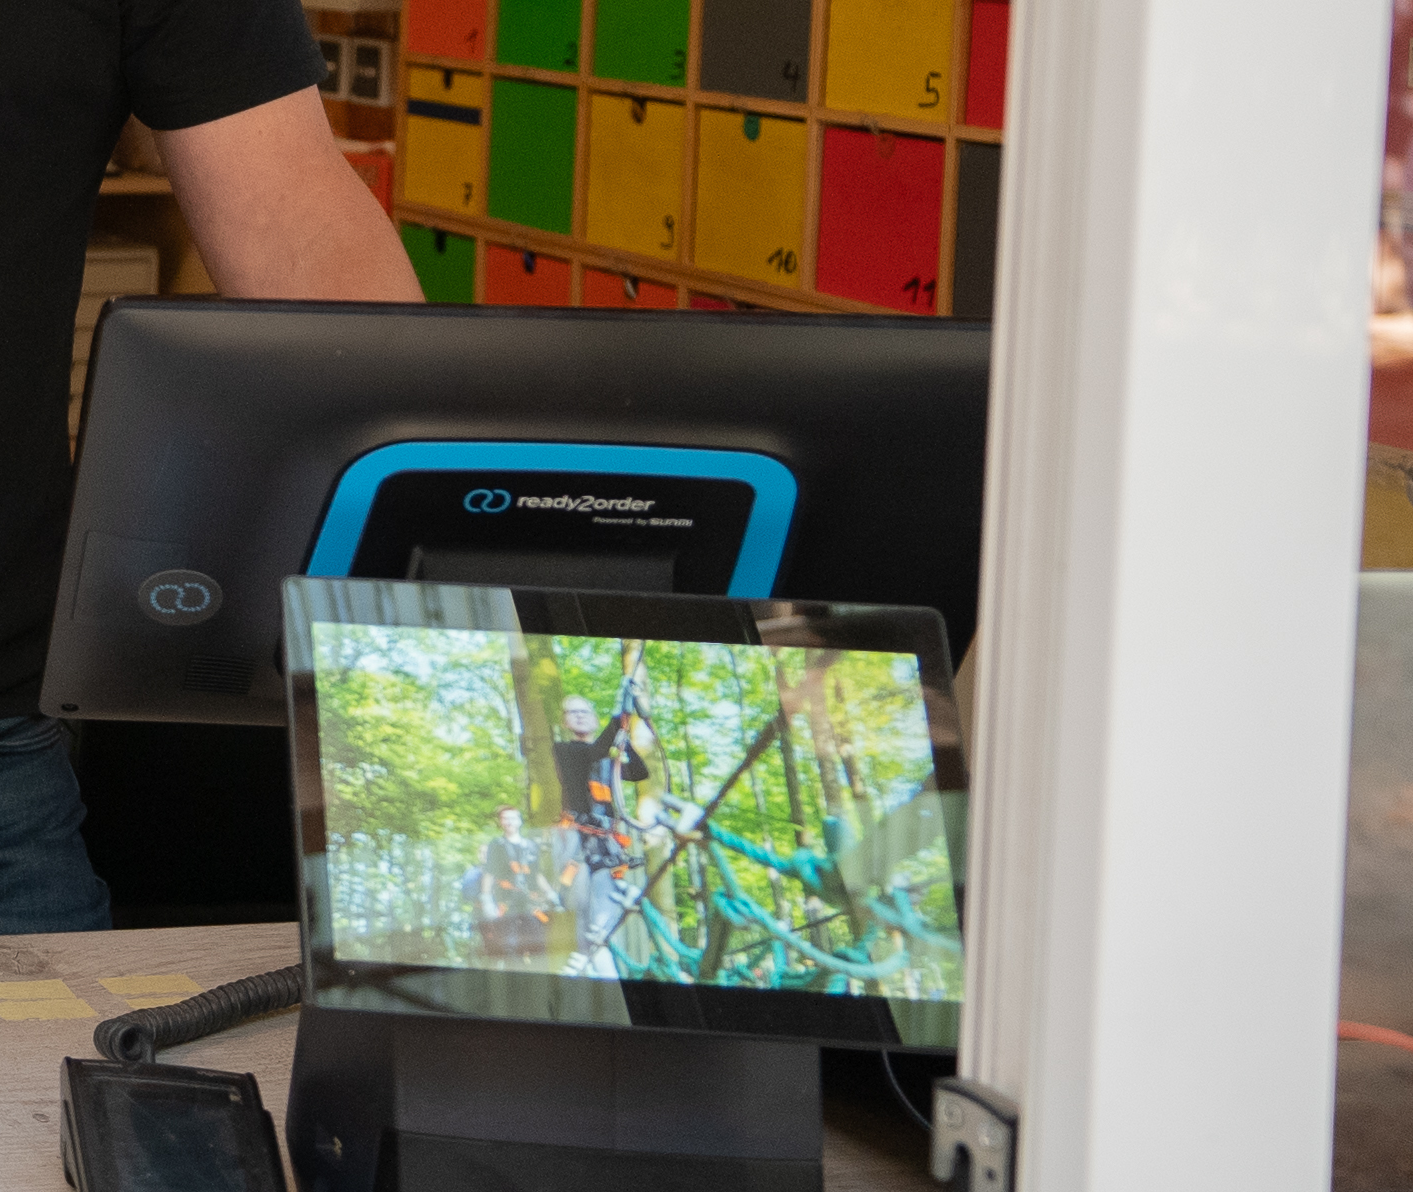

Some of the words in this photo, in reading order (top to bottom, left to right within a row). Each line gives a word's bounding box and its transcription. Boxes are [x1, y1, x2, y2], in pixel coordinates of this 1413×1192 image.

[464, 28, 479, 53] 1
[564, 41, 578, 66] 2
[670, 48, 686, 81] 3
[782, 60, 800, 93] 4
[918, 71, 942, 108] 5
[660, 214, 675, 250] 9
[767, 247, 798, 274] 10
[903, 276, 937, 307] 11
[516, 494, 656, 512] ready2order
